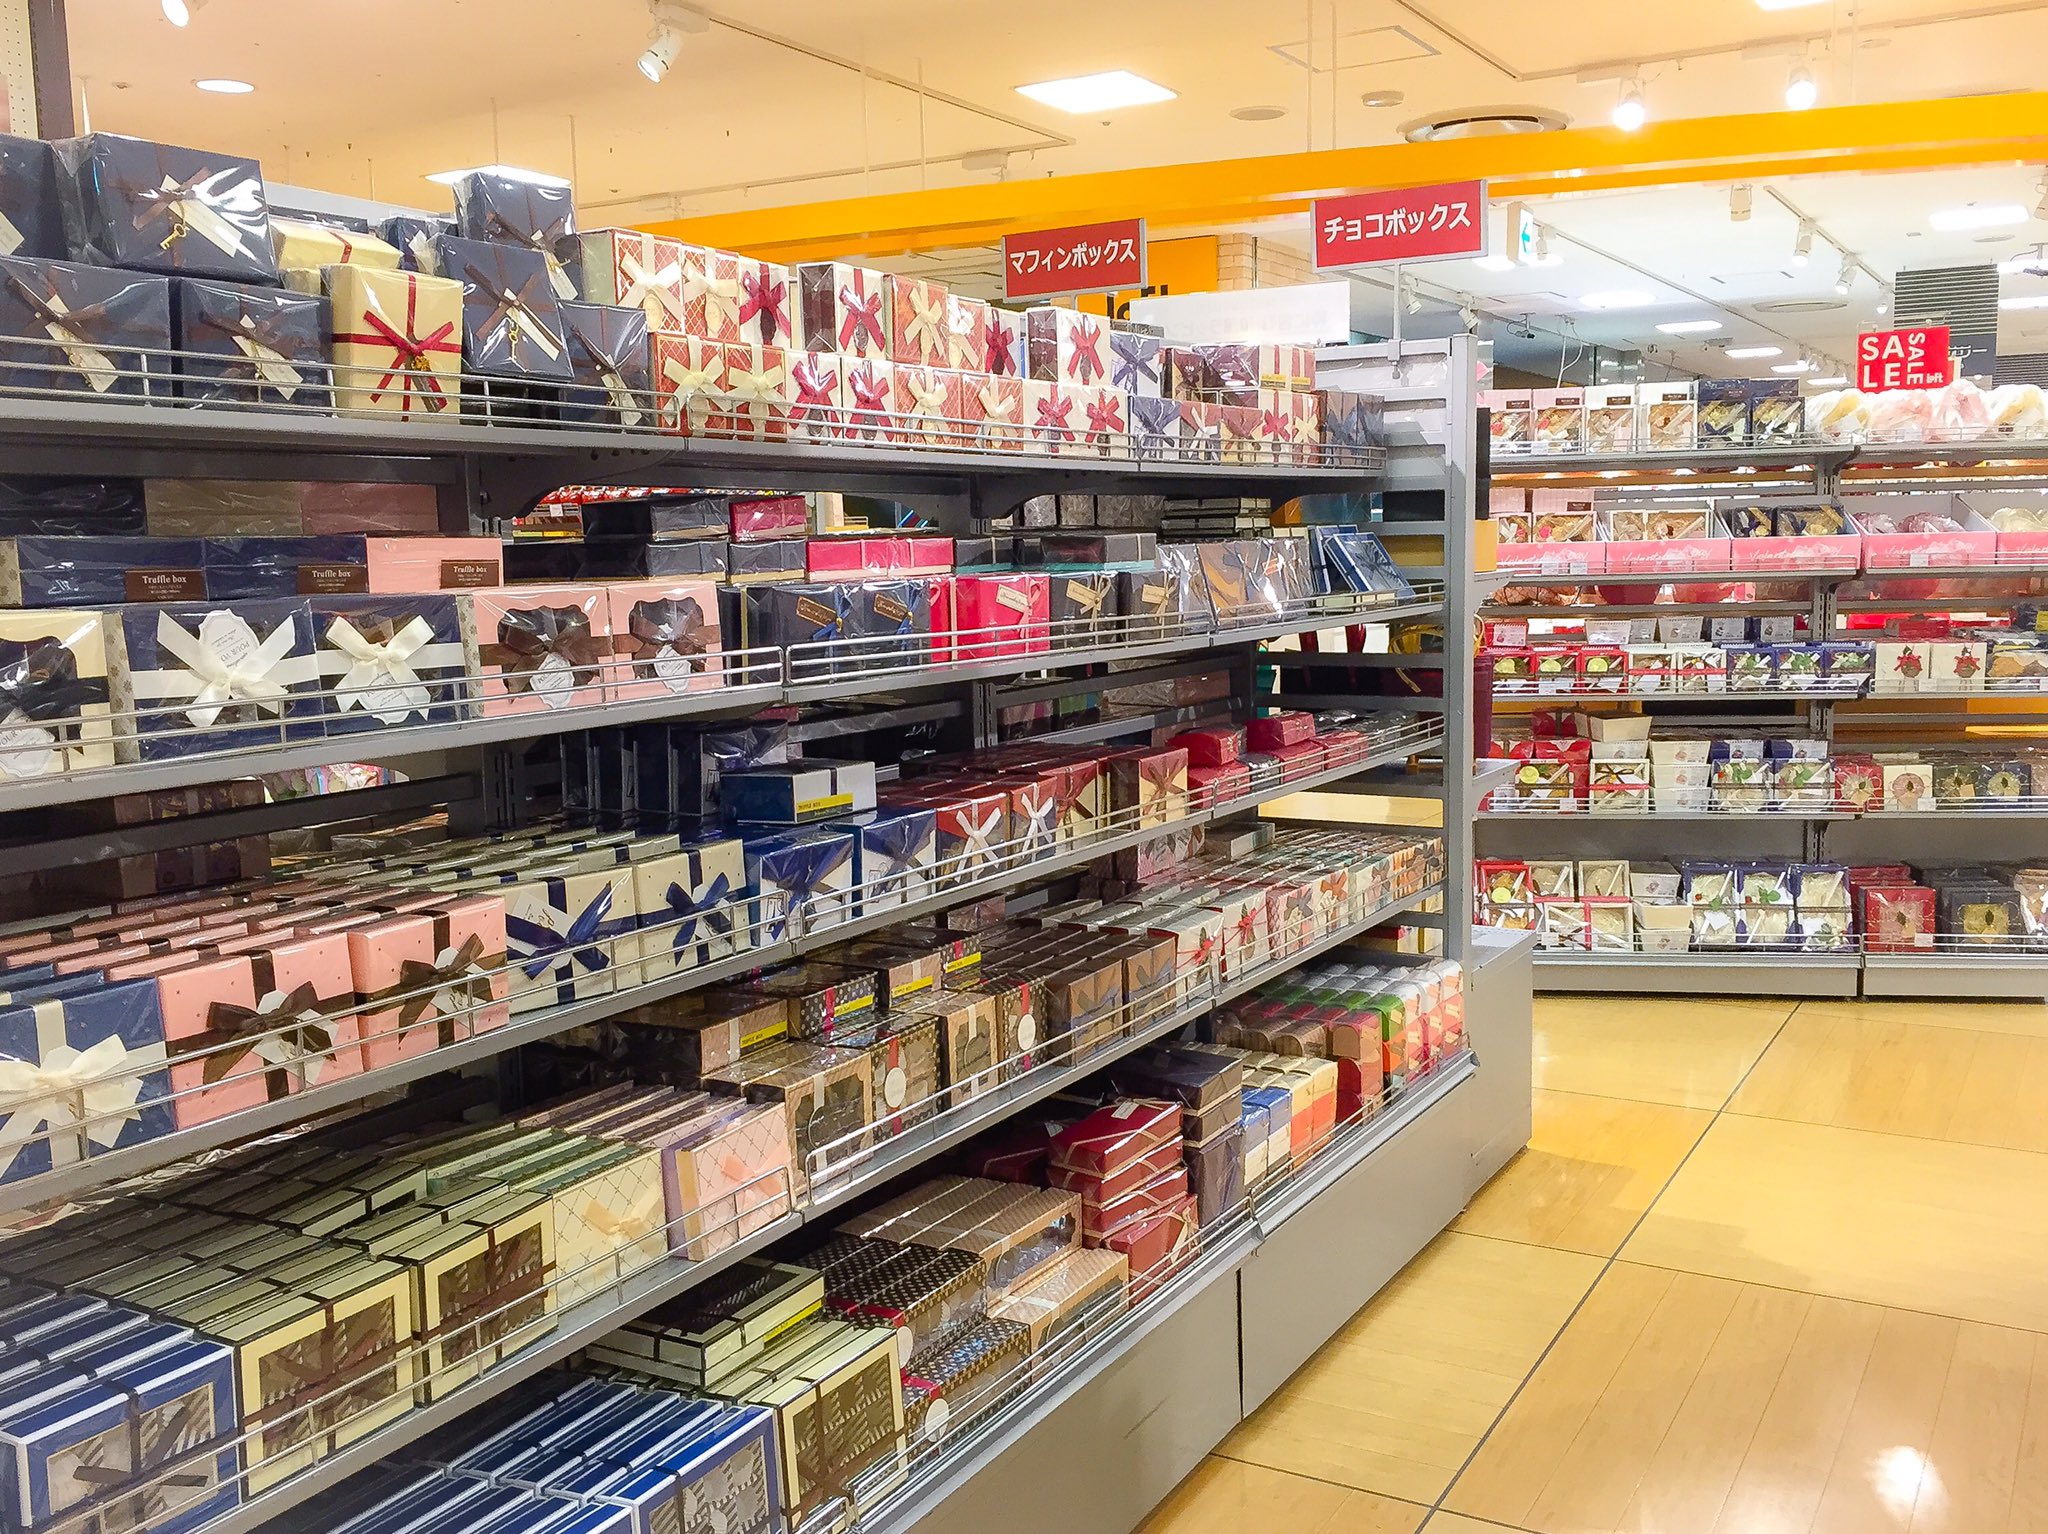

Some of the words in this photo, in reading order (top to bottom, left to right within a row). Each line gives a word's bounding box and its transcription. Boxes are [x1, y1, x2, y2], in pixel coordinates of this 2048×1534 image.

[1324, 202, 1472, 244] チョコボックス
[1010, 238, 1137, 275] マフィンボックス
[1861, 335, 1905, 361] SA
[1906, 332, 1926, 385] SALE
[1862, 362, 1901, 388] LE
[142, 575, 171, 584] Truffle
[172, 574, 187, 583] box
[311, 569, 338, 578] Truffle
[338, 569, 351, 577] box
[453, 565, 475, 573] Truffle
[475, 565, 487, 573] box
